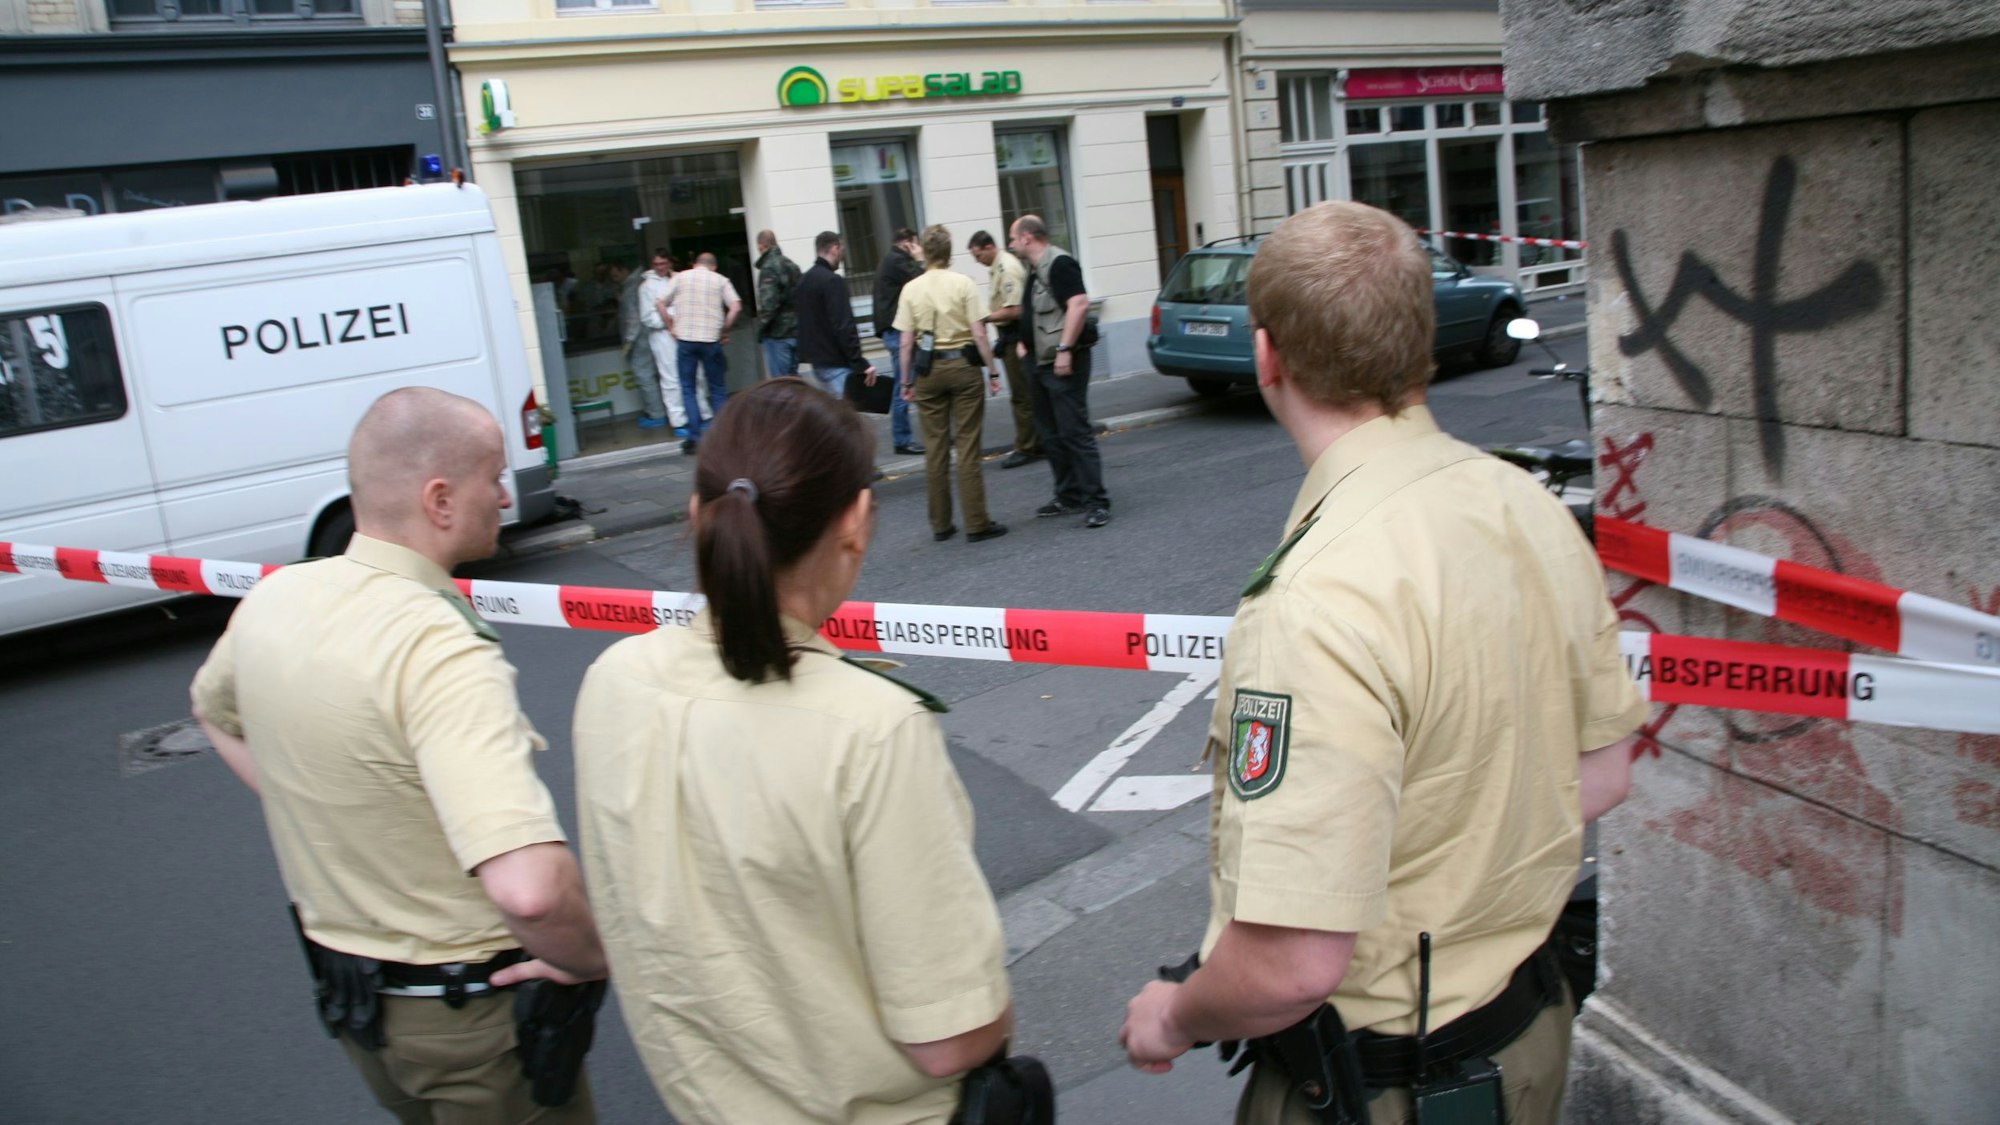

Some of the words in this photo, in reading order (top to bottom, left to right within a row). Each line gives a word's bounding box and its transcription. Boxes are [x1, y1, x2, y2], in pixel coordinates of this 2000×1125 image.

[220, 302, 411, 360] POLIZEI
[819, 617, 1049, 653] OLIZEIABSPERRUNG
[1126, 631, 1226, 660] POLIZEI
[1619, 652, 1876, 701] IABSPERRUNG
[1239, 698, 1282, 720] POLIZEI
